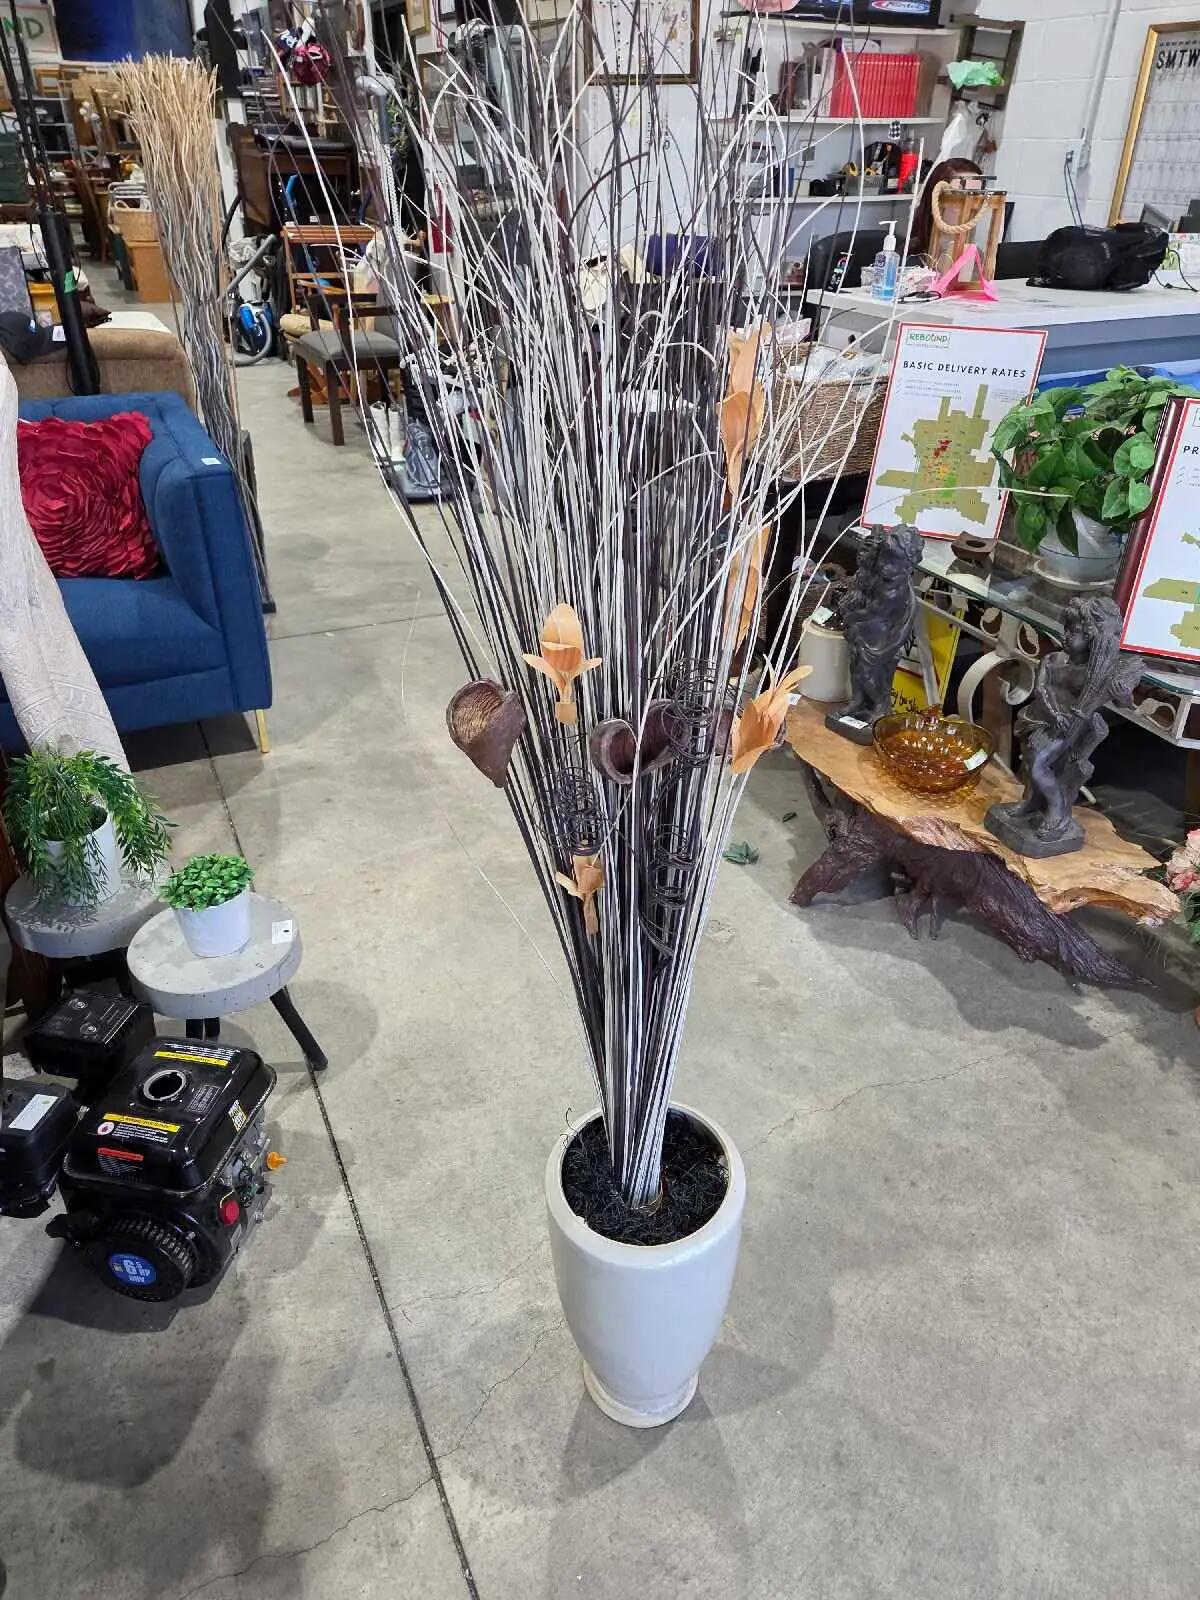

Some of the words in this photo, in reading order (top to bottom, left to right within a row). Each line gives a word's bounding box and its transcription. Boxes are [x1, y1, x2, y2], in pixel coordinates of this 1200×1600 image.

[909, 332, 948, 344] REBOUND
[903, 360, 936, 372] BASIC
[937, 363, 988, 375] DELIVERY
[991, 367, 1027, 379] RATES
